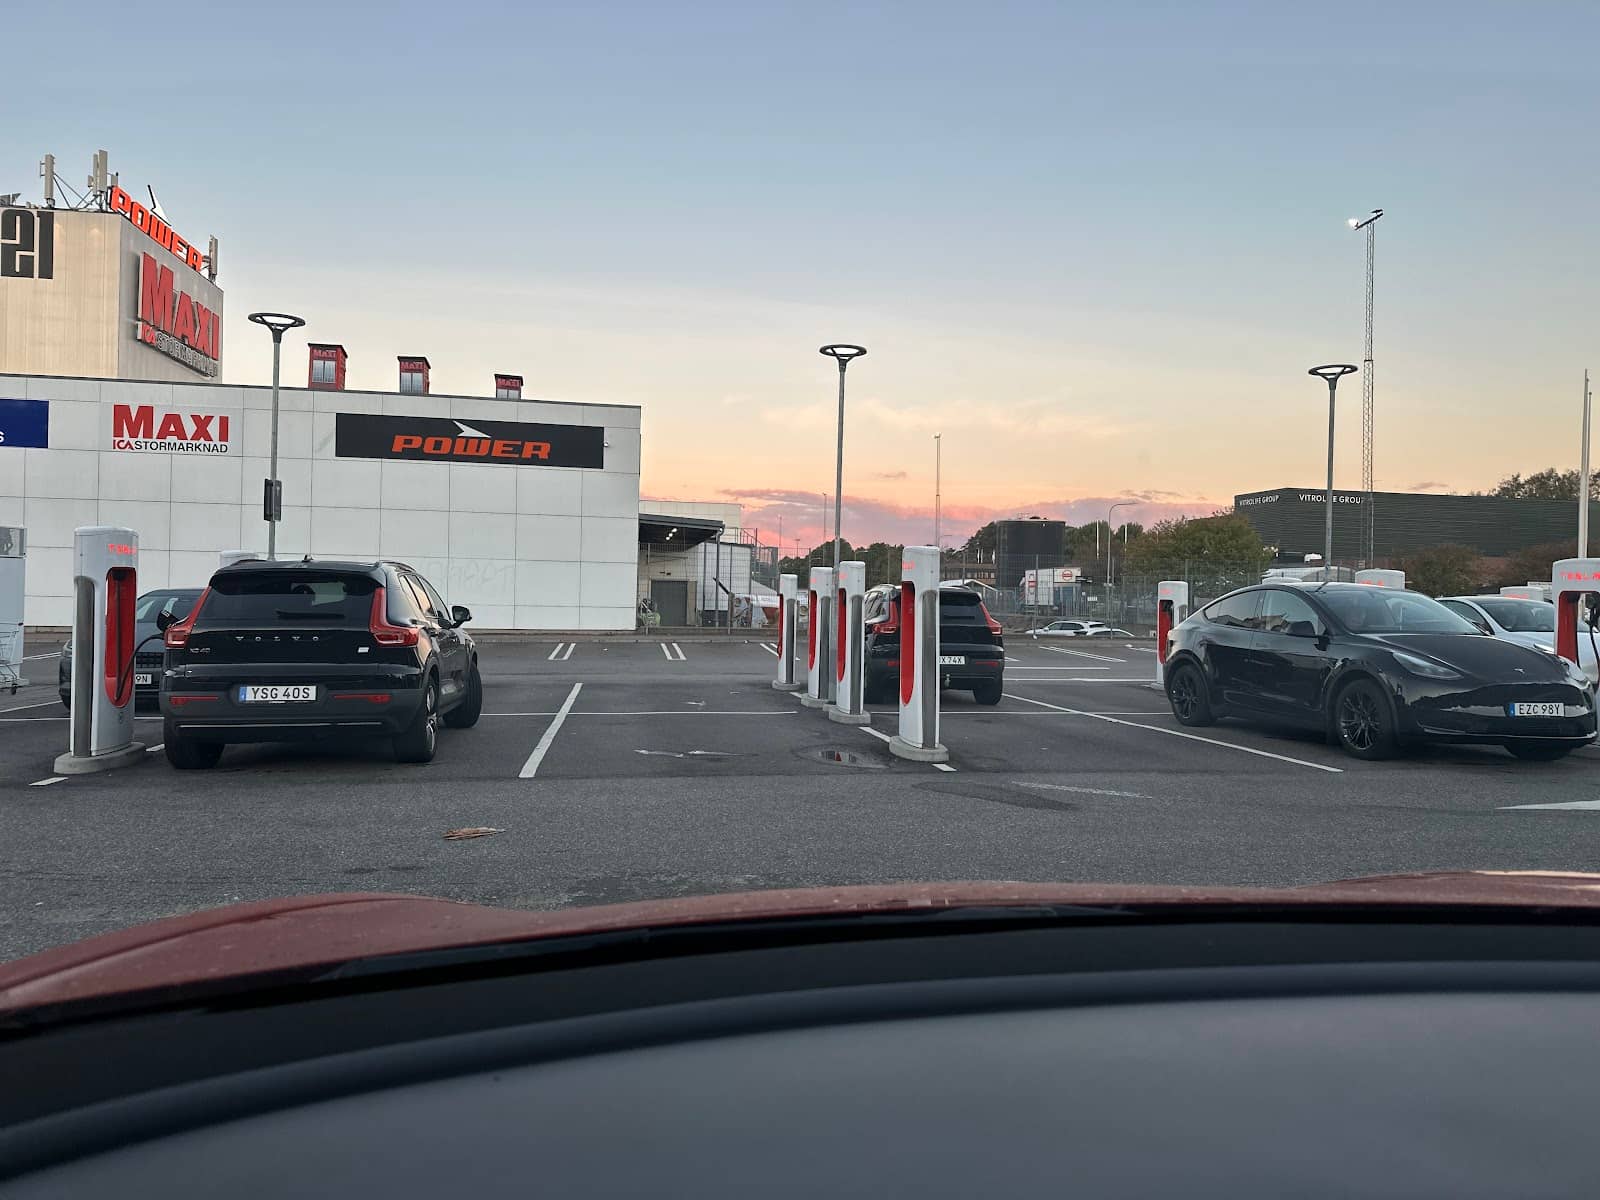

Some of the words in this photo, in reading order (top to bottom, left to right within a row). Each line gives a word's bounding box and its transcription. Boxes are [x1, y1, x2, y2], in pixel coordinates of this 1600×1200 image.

[1, 209, 54, 279] 21
[111, 186, 204, 272] POWER
[142, 252, 219, 361] MAXI
[113, 404, 229, 443] MAXI
[392, 435, 551, 459] POWER
[1299, 494, 1337, 503] VITROLE
[251, 687, 278, 699] YSG
[282, 687, 310, 699] 40S
[1519, 704, 1538, 715] EZC
[1541, 704, 1560, 715] 98Y
